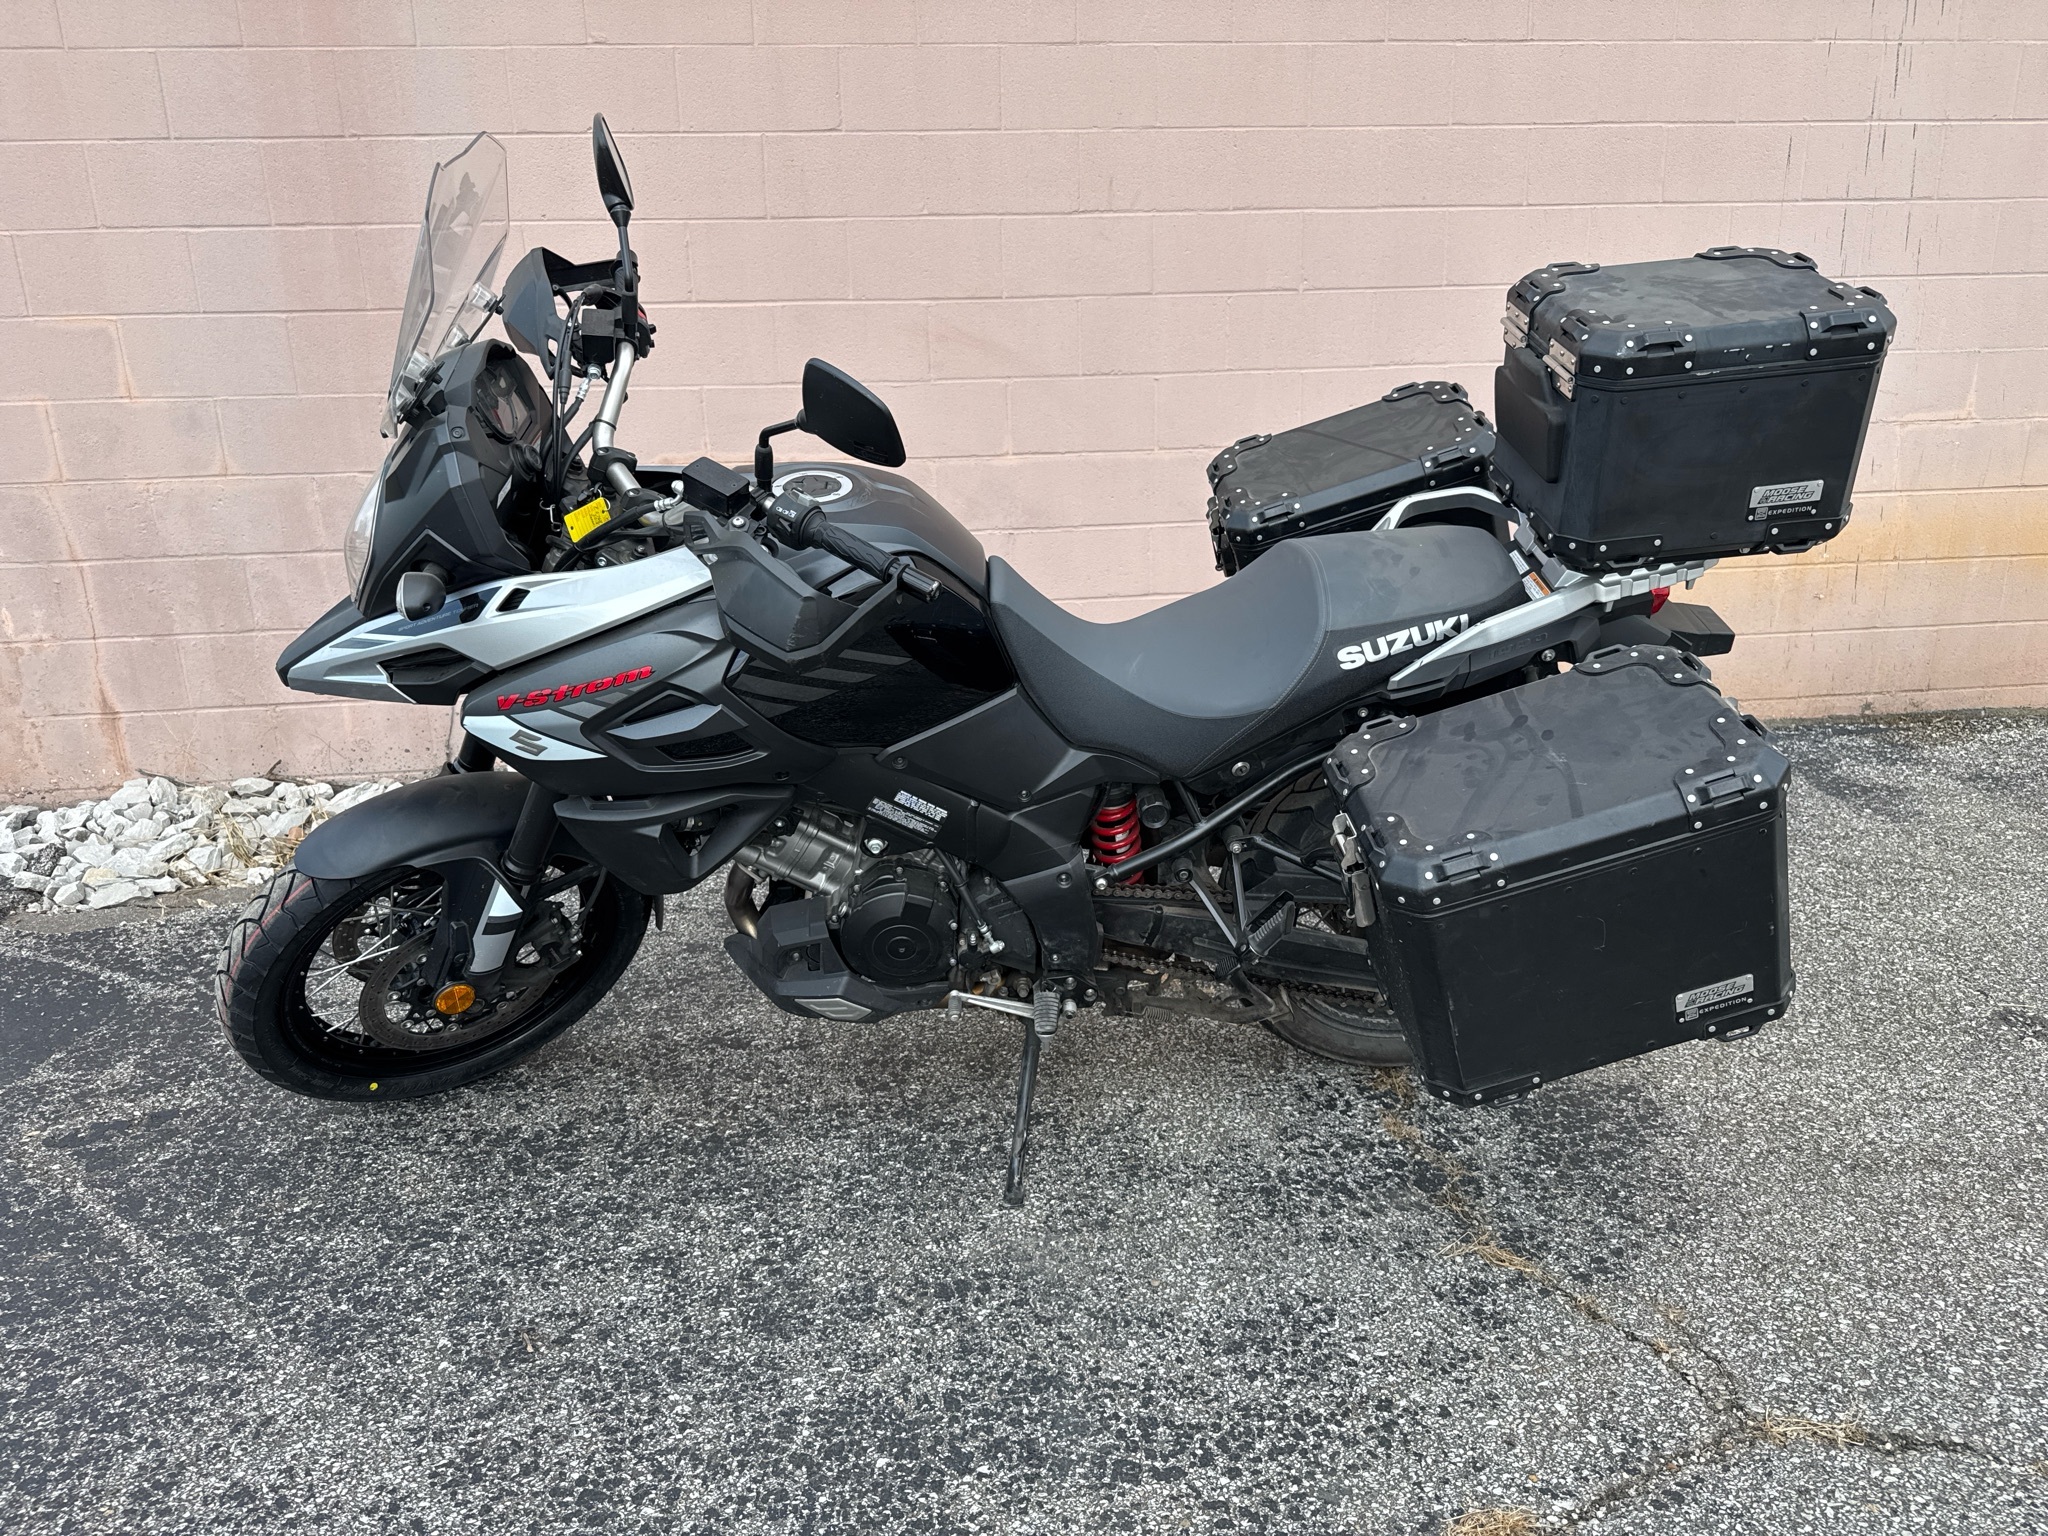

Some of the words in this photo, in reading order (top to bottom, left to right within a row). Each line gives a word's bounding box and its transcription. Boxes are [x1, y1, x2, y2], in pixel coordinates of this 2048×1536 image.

[1764, 486, 1808, 497] MOOSE
[1768, 491, 1814, 503] RACING
[1768, 506, 1812, 516] EXPEDITION
[1337, 613, 1469, 670] SUZUKI
[496, 665, 655, 711] V-Strom
[1689, 982, 1735, 1000] MOOSE
[1696, 985, 1745, 1004] RACING
[1699, 996, 1747, 1014] EXPEDITION
